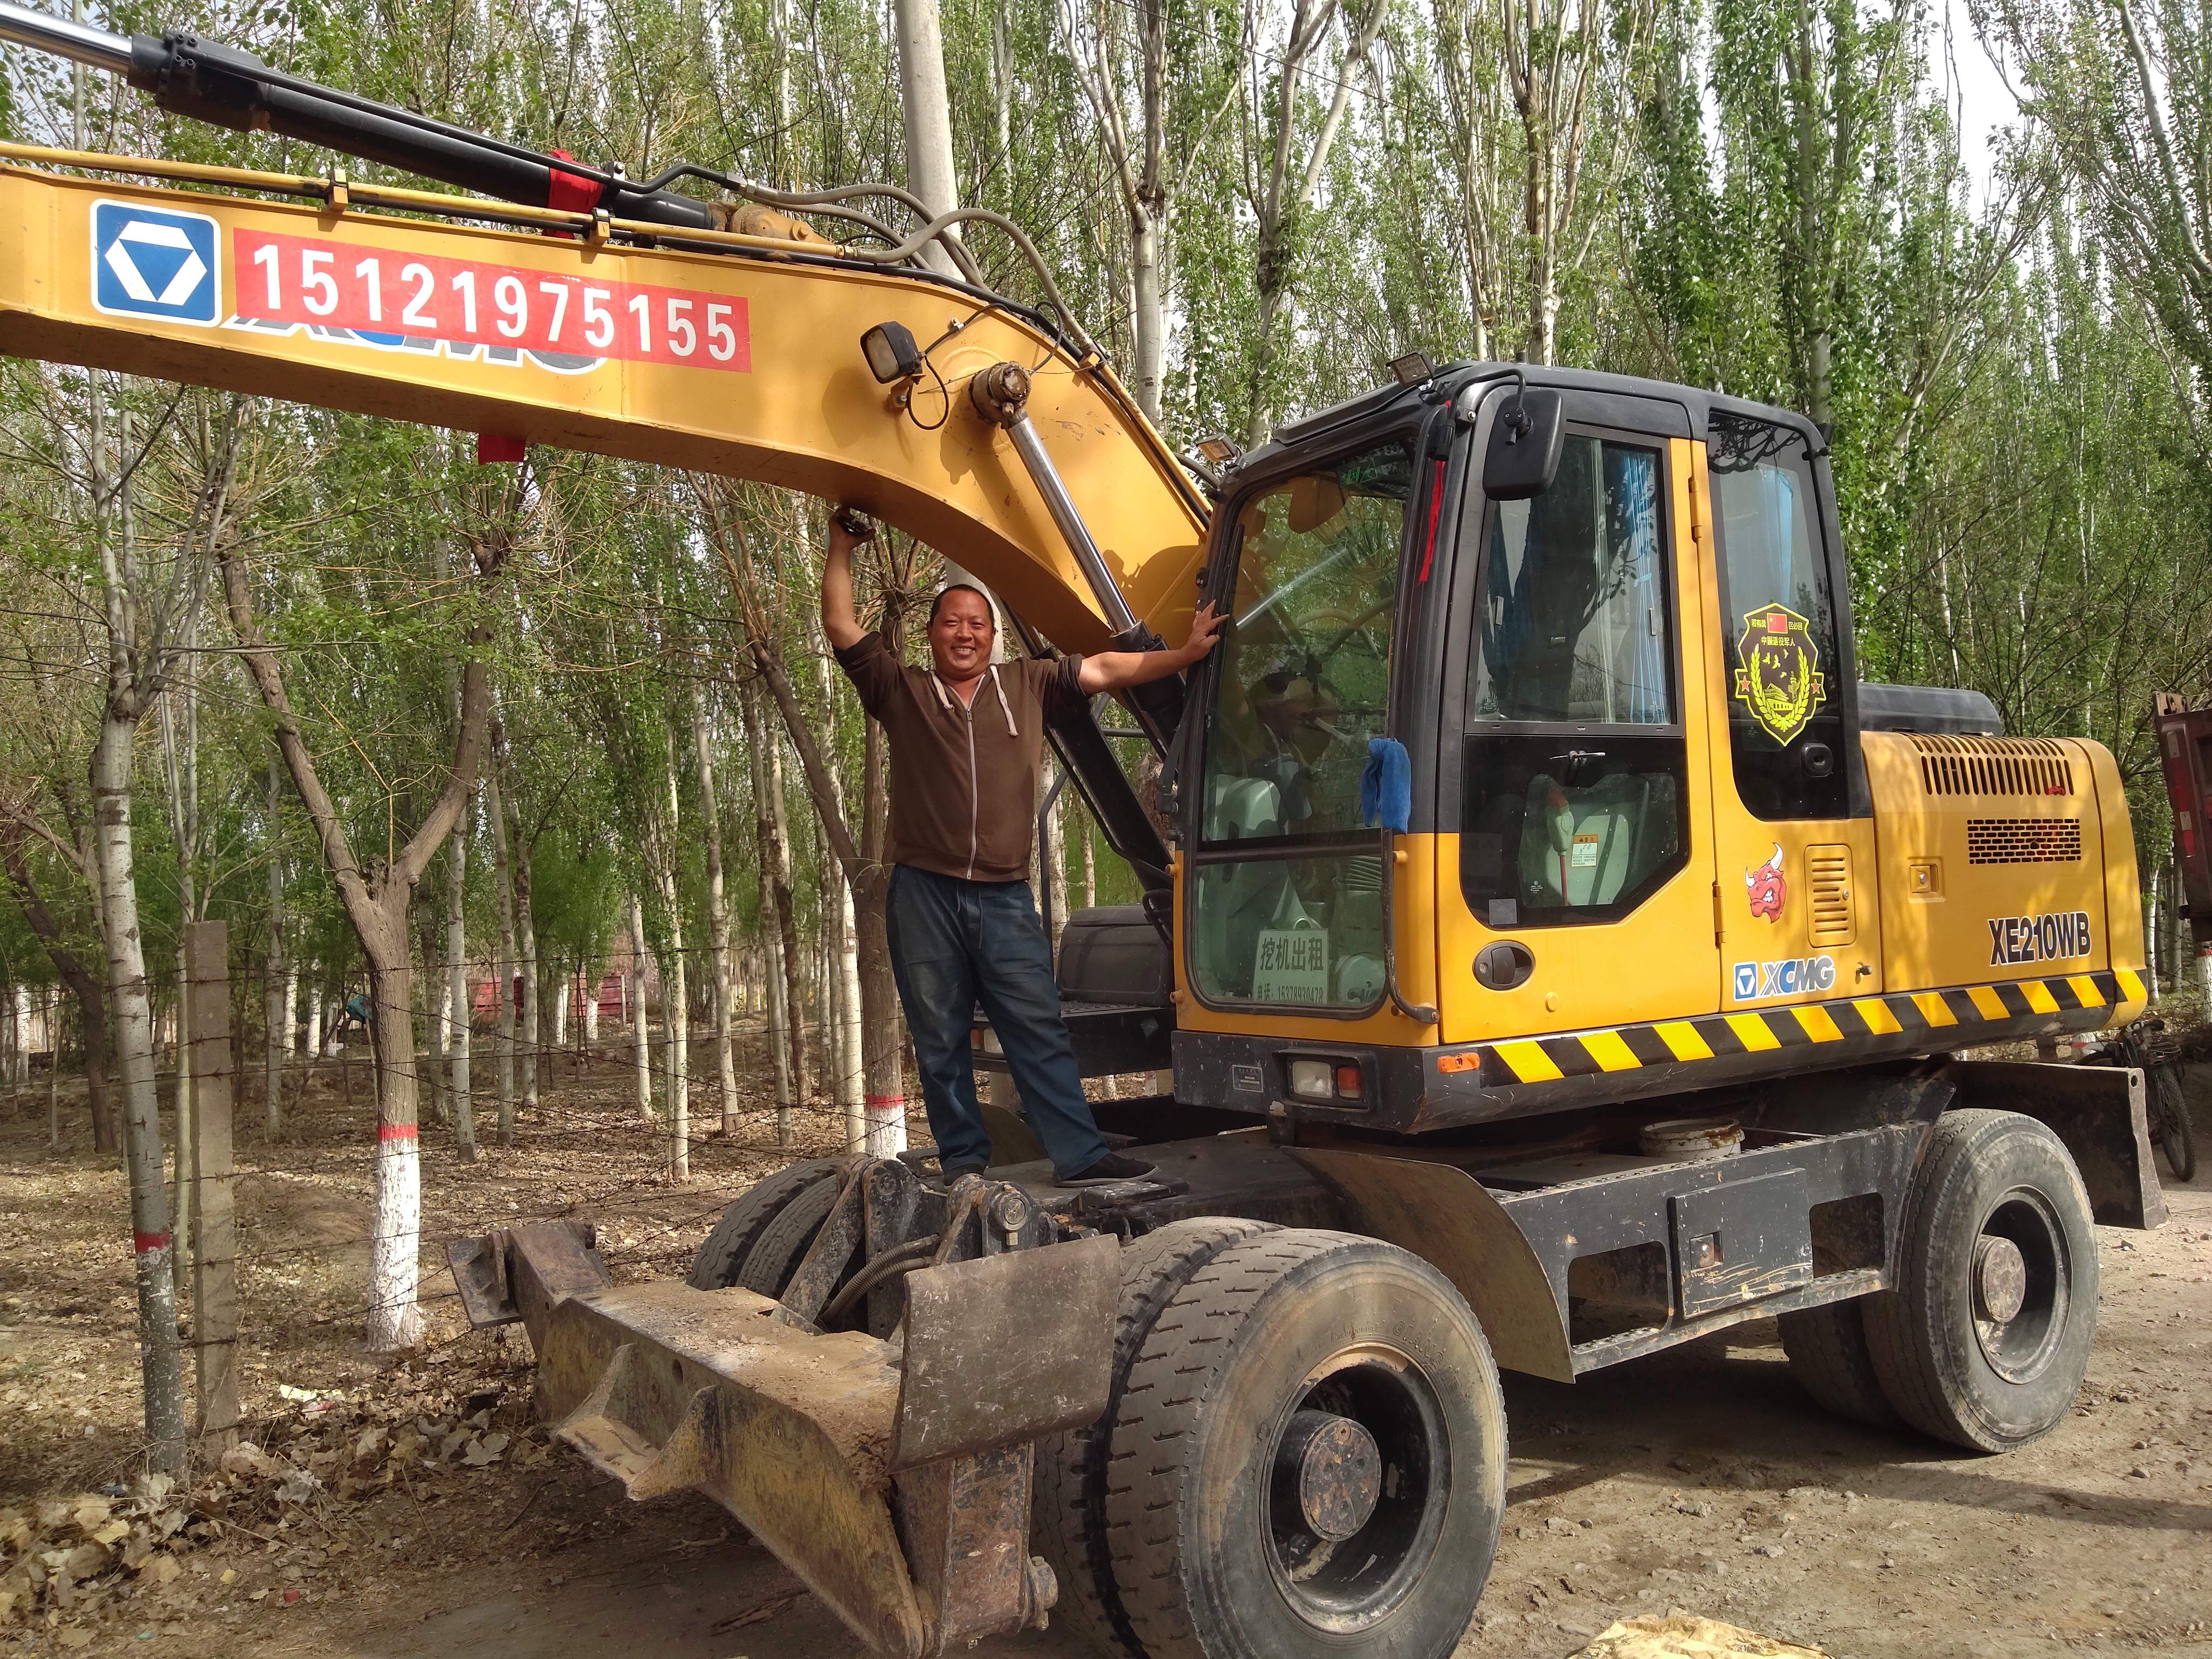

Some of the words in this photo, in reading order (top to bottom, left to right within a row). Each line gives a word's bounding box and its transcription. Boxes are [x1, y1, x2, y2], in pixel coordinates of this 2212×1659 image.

[253, 244, 737, 362] 15121975155
[1761, 635, 1796, 647] 中国退役军人
[1789, 621, 1803, 630] 召必回
[1259, 937, 1323, 971] 挖机出租
[1988, 912, 2091, 967] XE210WB
[1758, 955, 1835, 997] XCMG
[1278, 985, 1323, 1004] 15378930478
